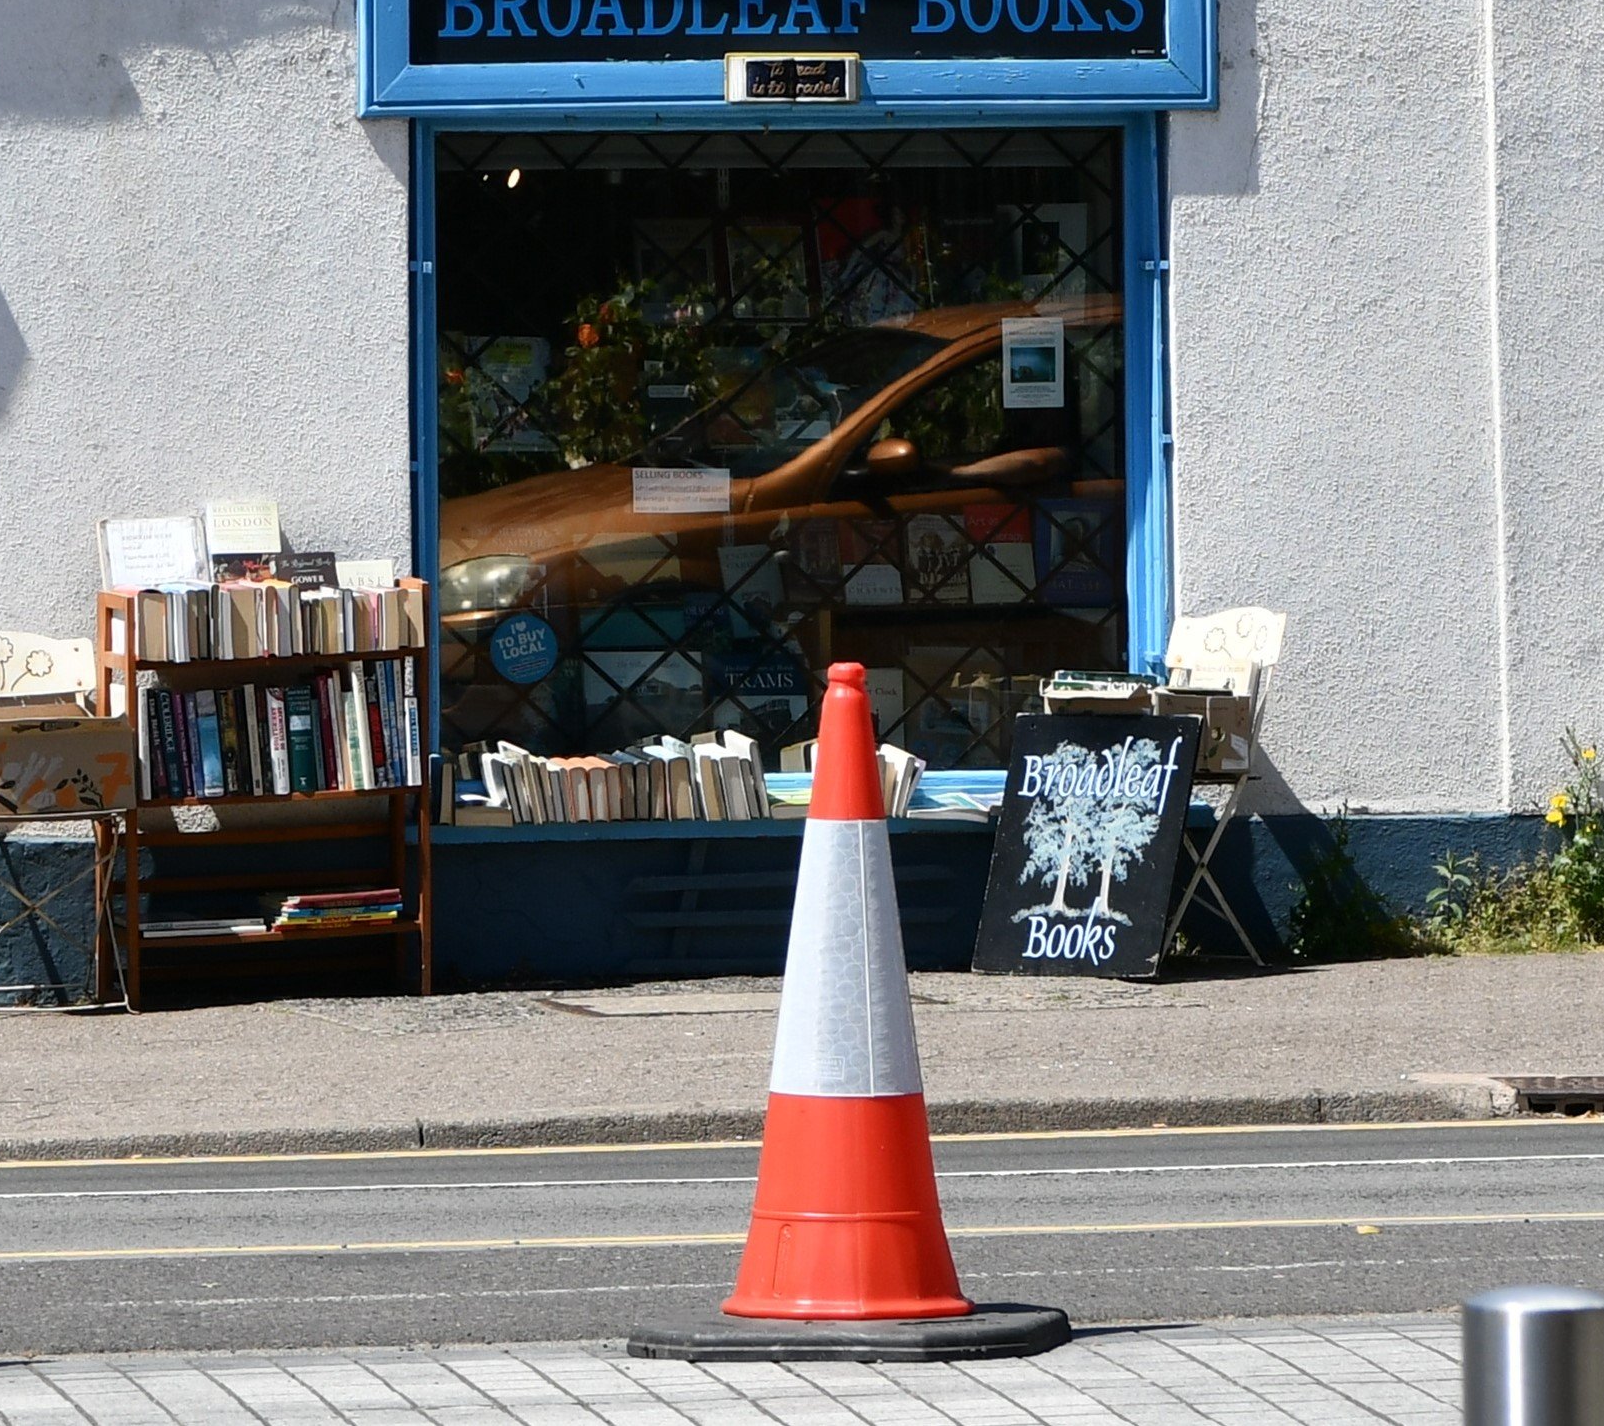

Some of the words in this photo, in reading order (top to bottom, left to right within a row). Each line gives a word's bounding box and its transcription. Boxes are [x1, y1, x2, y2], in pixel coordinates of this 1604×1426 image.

[635, 470, 671, 479] SELLING
[673, 470, 703, 479] BOOKS
[214, 517, 272, 527] LONDON
[291, 575, 325, 585] GOWER
[495, 636, 514, 649] TO
[518, 628, 545, 645] BUY
[502, 641, 546, 660] LOCAL
[160, 692, 175, 752] COLERIDGE
[1017, 736, 1183, 815] Broadleaf
[1022, 896, 1116, 966] Books
